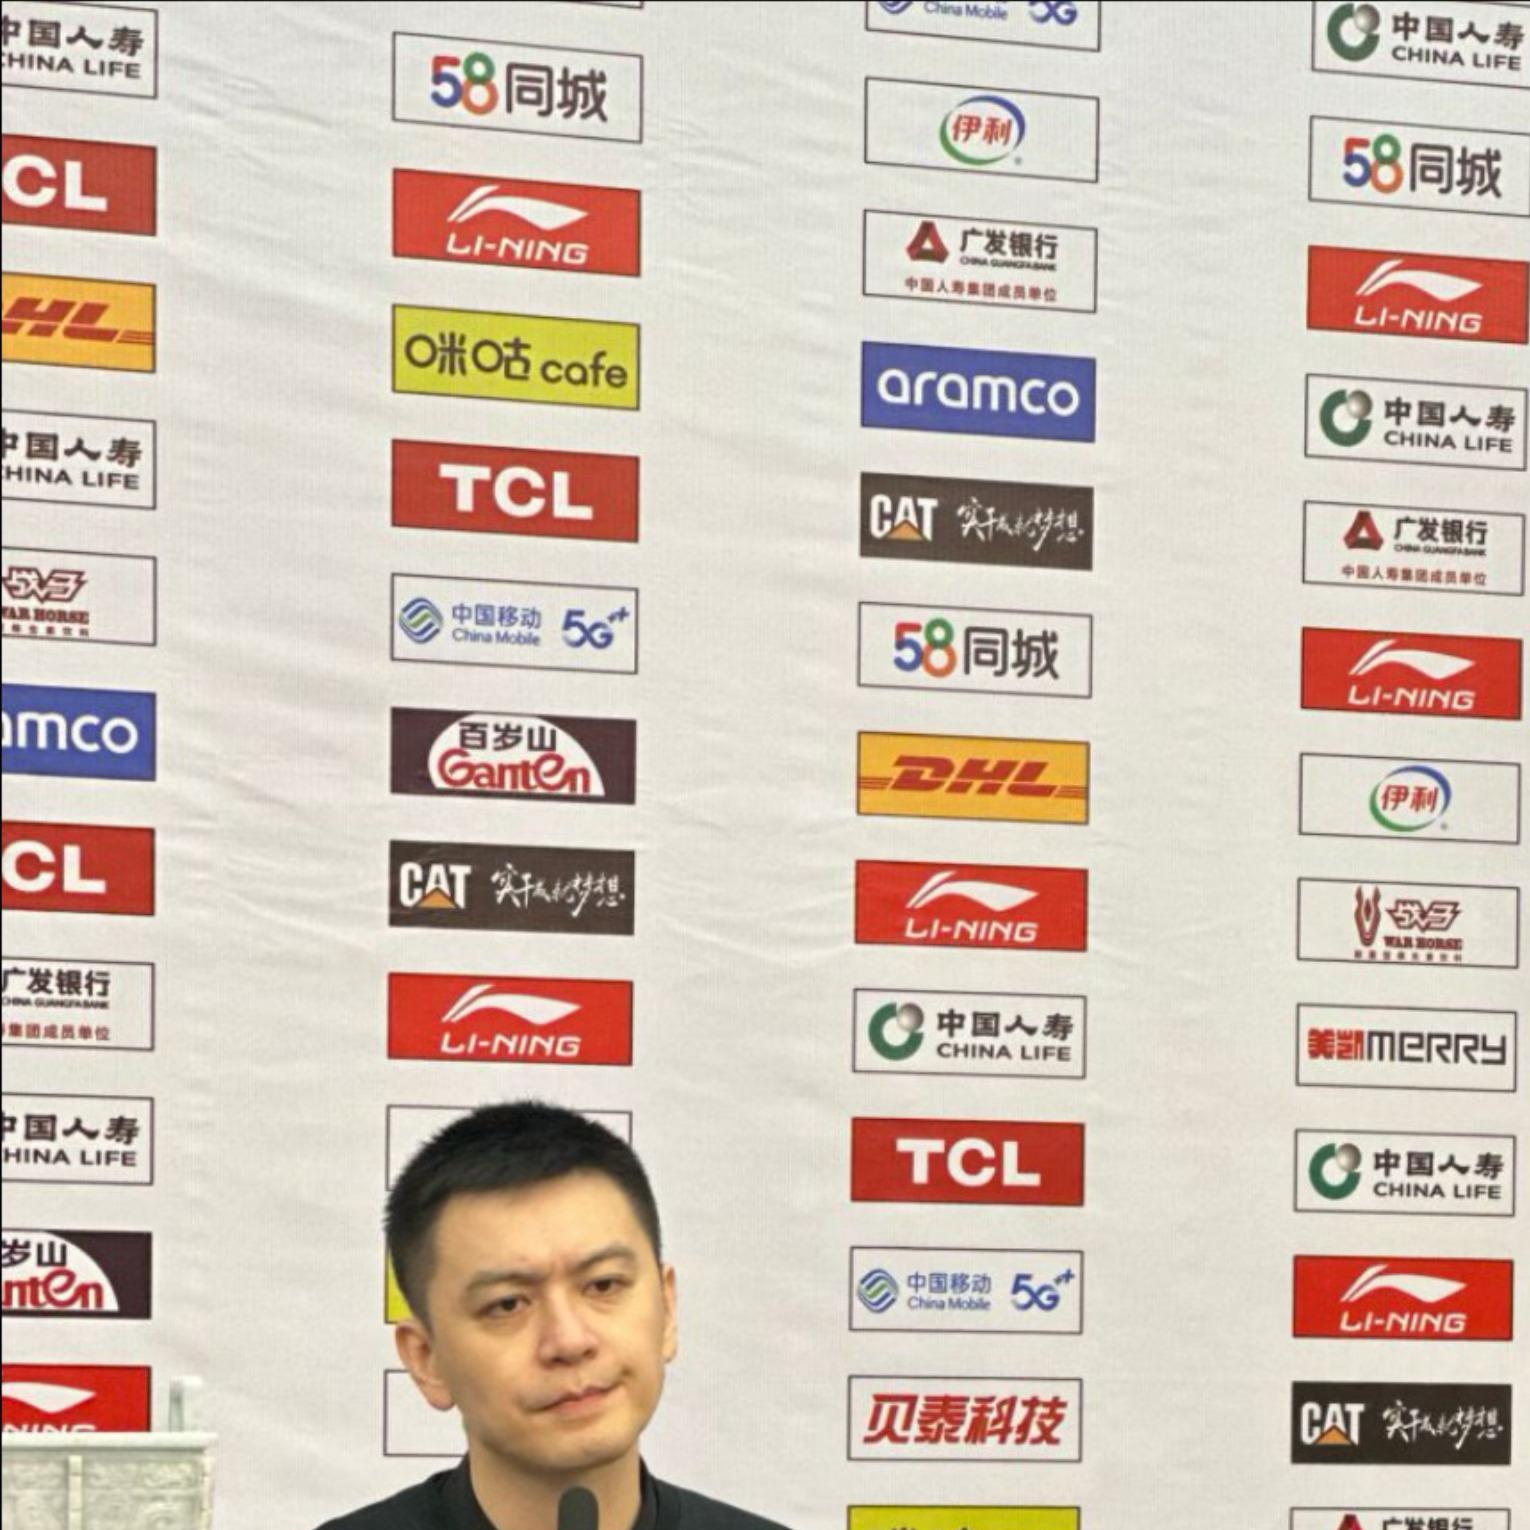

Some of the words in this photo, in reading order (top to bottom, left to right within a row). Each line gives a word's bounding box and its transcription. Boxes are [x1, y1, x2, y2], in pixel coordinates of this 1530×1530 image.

[2, 15, 144, 57] 中国人寿
[1392, 12, 1525, 50] 中国人寿
[2, 53, 74, 74] HINA
[84, 59, 142, 79] LIFE
[1391, 46, 1464, 66] CHINA
[1473, 53, 1521, 71] LIFE
[431, 51, 608, 122] 58同城
[952, 114, 1012, 146] 伊利
[1344, 133, 1502, 199] 58同城
[2, 154, 107, 212] CL
[447, 233, 589, 265] LI-NING
[960, 228, 1058, 259] 广发银行
[2, 297, 120, 342] HL
[1355, 305, 1483, 333] LI-NING
[404, 331, 531, 381] 咪咕
[540, 351, 628, 388] cafe
[877, 368, 1080, 416] aramco
[1384, 397, 1516, 433] 中国人寿
[1384, 430, 1457, 450] CHINA
[1465, 435, 1512, 453] LIFE
[2, 464, 73, 485] HINA
[82, 471, 140, 490] LIFE
[439, 464, 594, 520] TCL
[870, 494, 938, 541] CAT
[1394, 517, 1488, 545] 广发银行
[452, 603, 542, 630] 中国移动
[452, 628, 493, 645] China
[495, 630, 541, 646] Mobile
[893, 617, 1059, 680] 58同城
[1347, 685, 1476, 709] LI-NING
[458, 722, 558, 752] 百岁山
[891, 755, 1058, 798] DHL
[1381, 784, 1440, 813] 伊利
[2, 840, 107, 893] CL
[400, 862, 472, 908] CAT
[905, 917, 1038, 943] LI-NING
[2, 967, 111, 997] 广发银行
[937, 1008, 1074, 1041] 中国人寿
[440, 1032, 582, 1058] LI-NING
[936, 1042, 1012, 1060] CHINA
[1020, 1045, 1071, 1062] LIFE
[2, 1148, 71, 1166] HINA
[81, 1150, 137, 1168] LIFE
[896, 1138, 1041, 1187] TCL
[1373, 1149, 1505, 1180] 中国人寿
[1373, 1181, 1445, 1198] CHINA
[1453, 1184, 1502, 1200] LIFE
[2, 1239, 68, 1268] 岁山
[2, 1268, 103, 1309] nten
[907, 1271, 992, 1294] 中国移动
[907, 1295, 945, 1310] China
[948, 1297, 991, 1312] Mobile
[1339, 1310, 1468, 1333] LI-NING
[863, 1393, 1068, 1446] 贝泰科技
[1301, 1402, 1366, 1446] CAT
